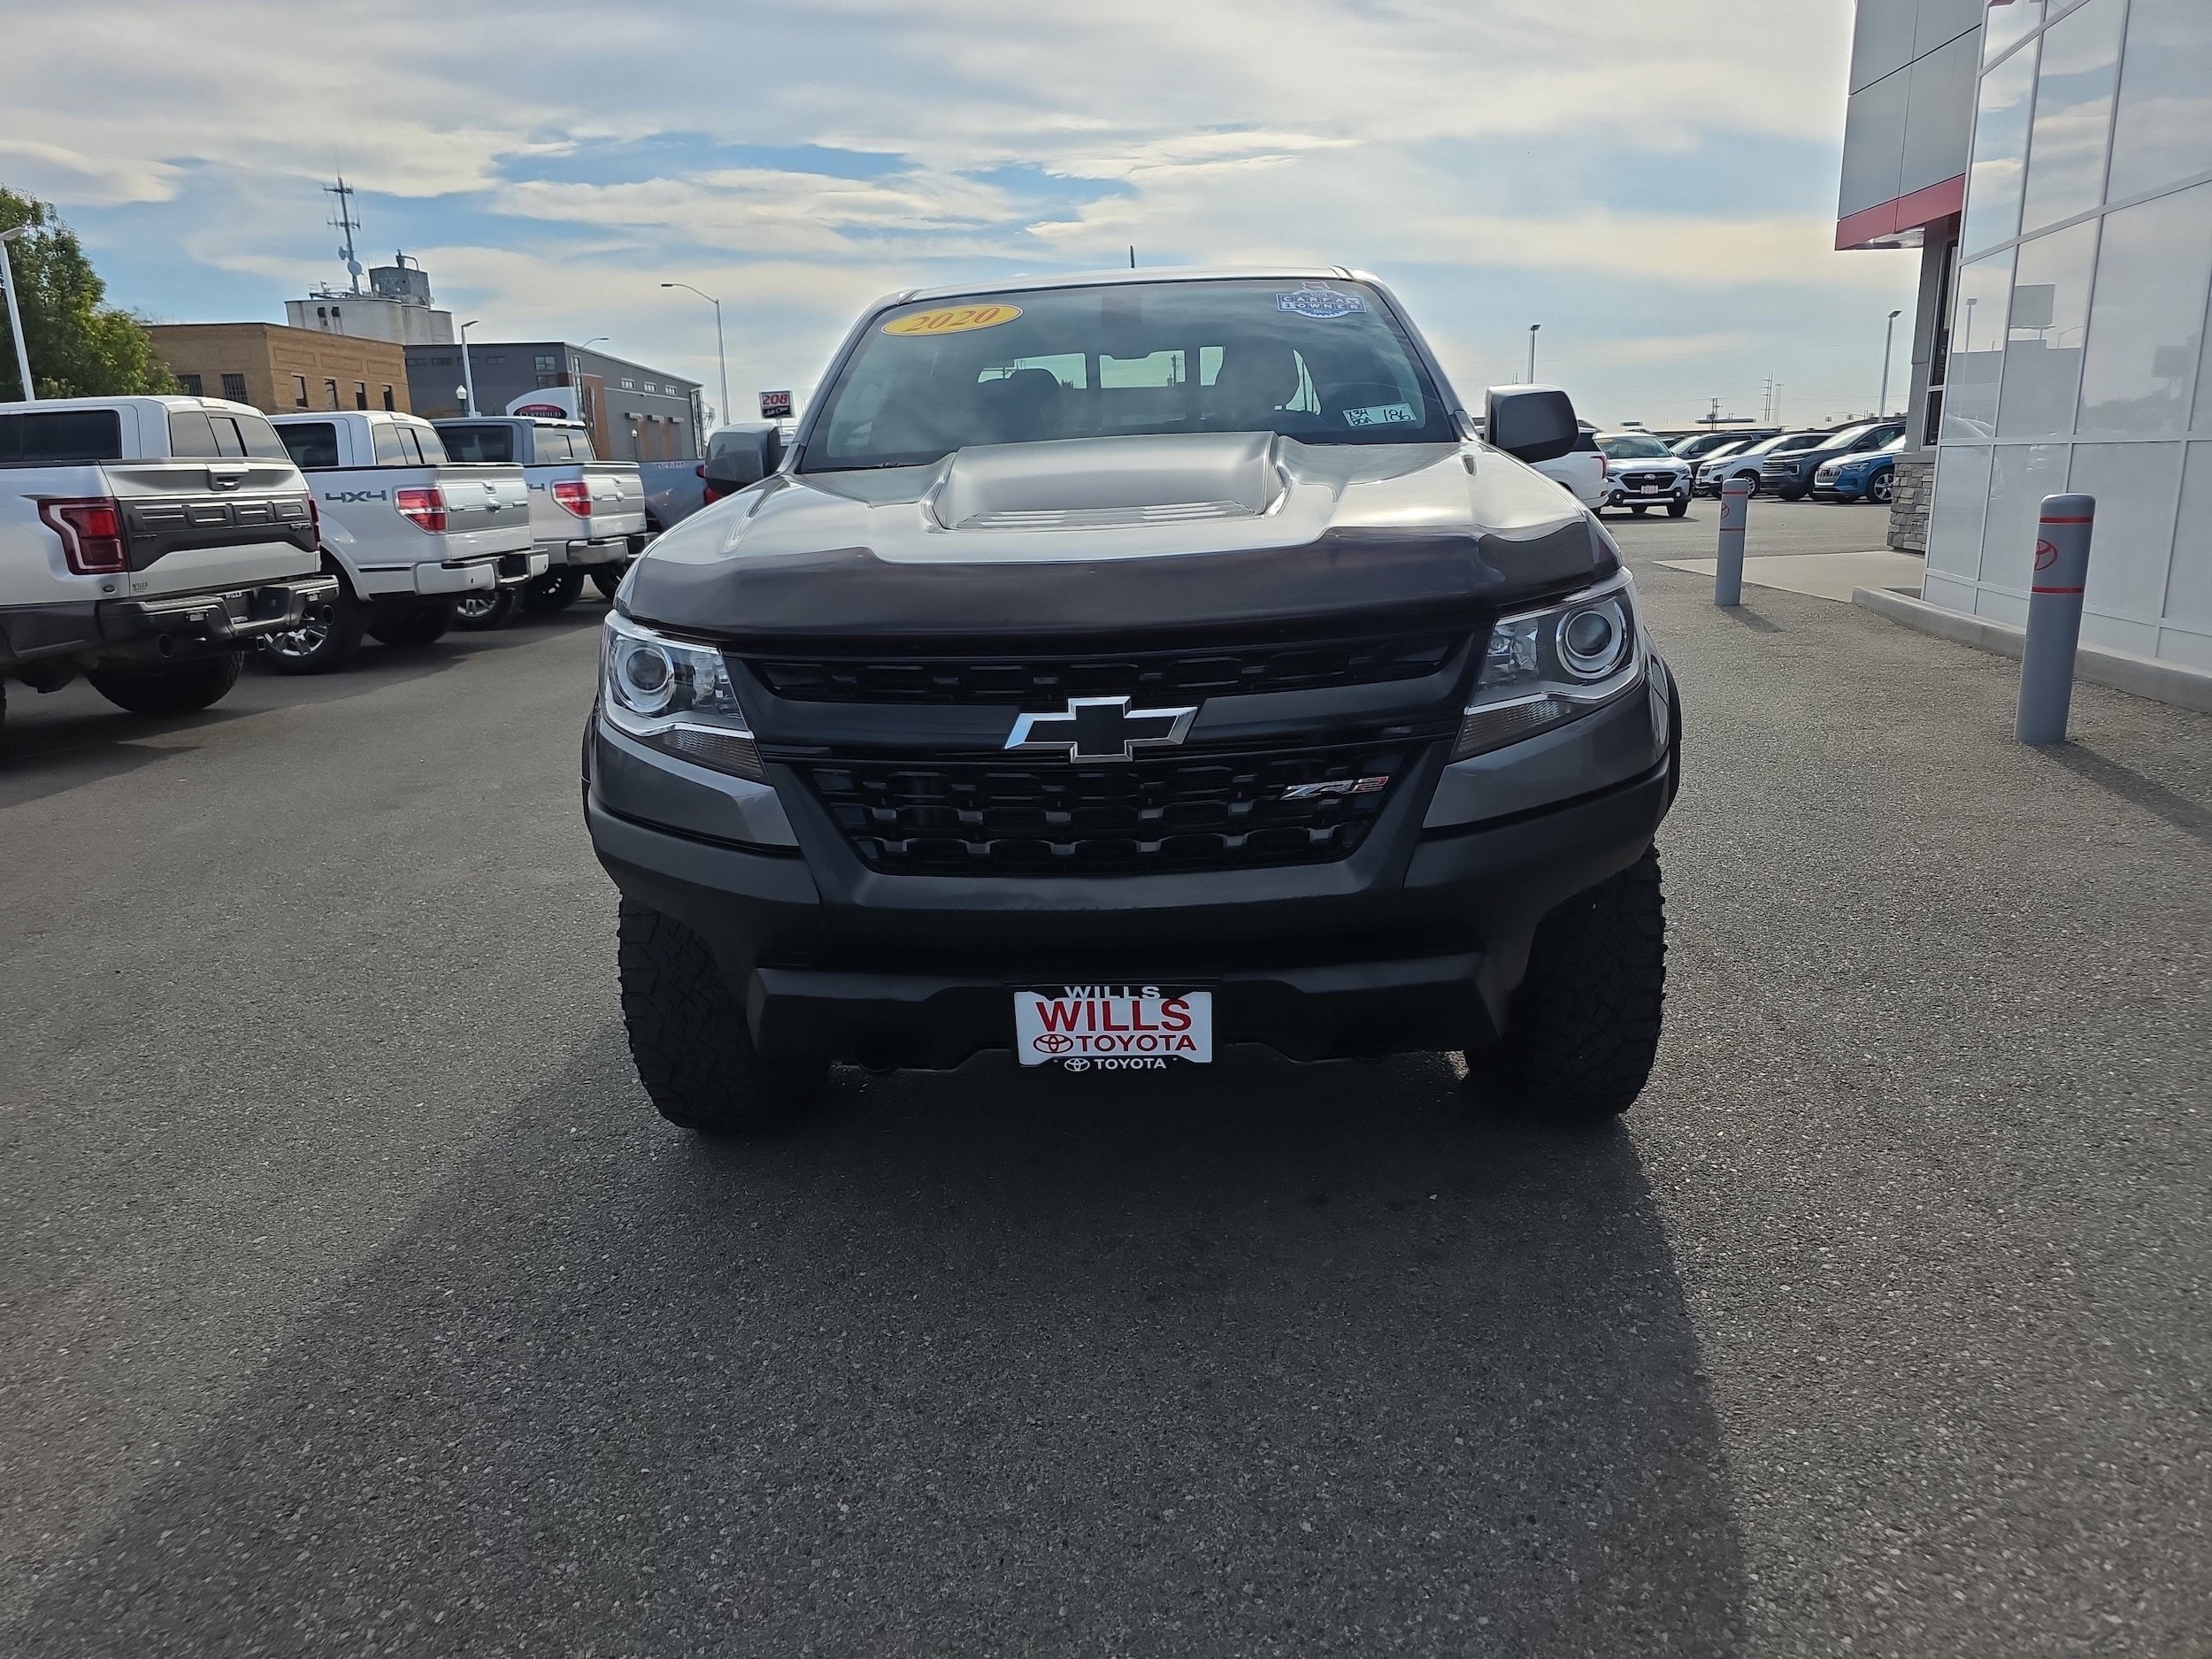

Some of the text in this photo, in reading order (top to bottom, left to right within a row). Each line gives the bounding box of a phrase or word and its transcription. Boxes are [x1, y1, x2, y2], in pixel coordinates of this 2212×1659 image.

[902, 307, 1001, 333] 2020
[763, 394, 787, 404] 208
[1383, 408, 1411, 422] 186
[326, 490, 387, 503] 4X4
[129, 498, 308, 531] FORD
[1279, 775, 1389, 801] ZR2
[1064, 986, 1161, 999] WILLS
[1035, 999, 1193, 1032] WILLS
[1075, 1034, 1197, 1052] TOYOTA
[1094, 1058, 1167, 1070] TOYOTA
